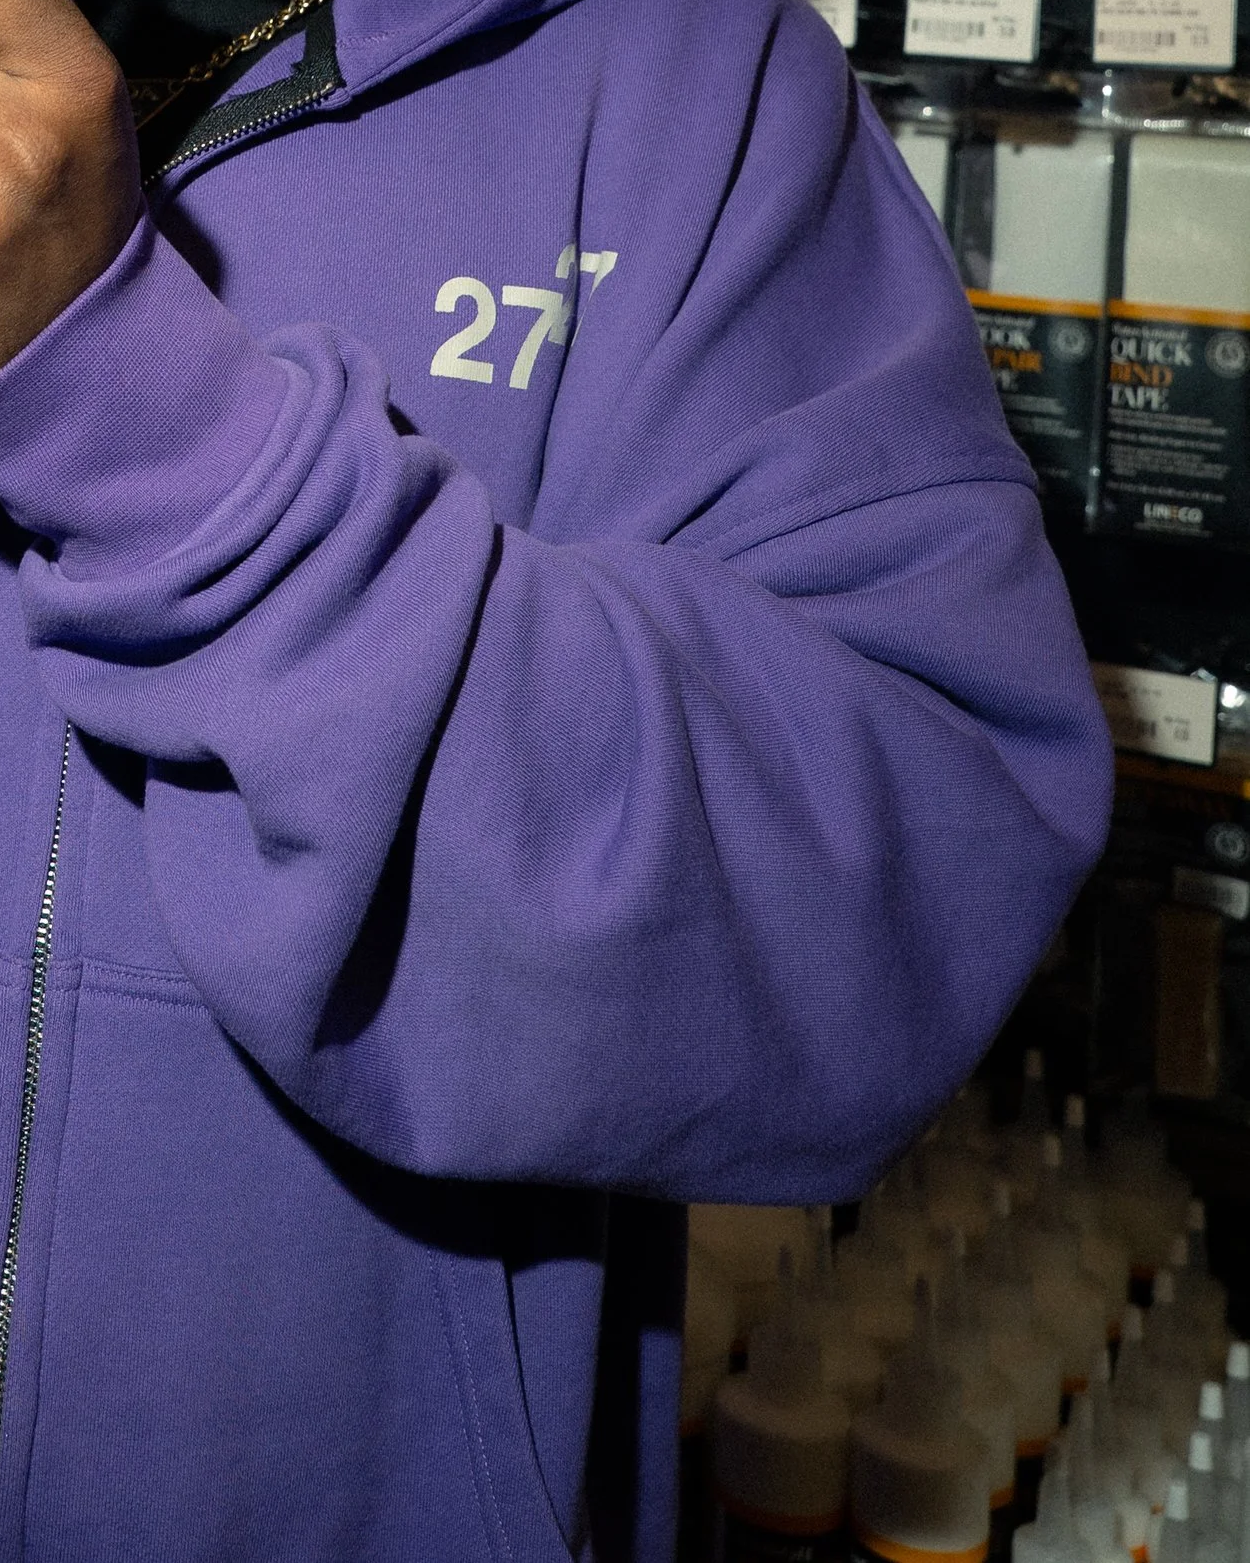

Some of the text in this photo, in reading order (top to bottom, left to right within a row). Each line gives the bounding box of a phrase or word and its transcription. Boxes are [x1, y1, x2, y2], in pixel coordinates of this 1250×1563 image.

[430, 276, 564, 390] 27
[1110, 337, 1193, 368] QUICK
[1110, 362, 1174, 387] BIND
[1108, 383, 1170, 413] TAPE
